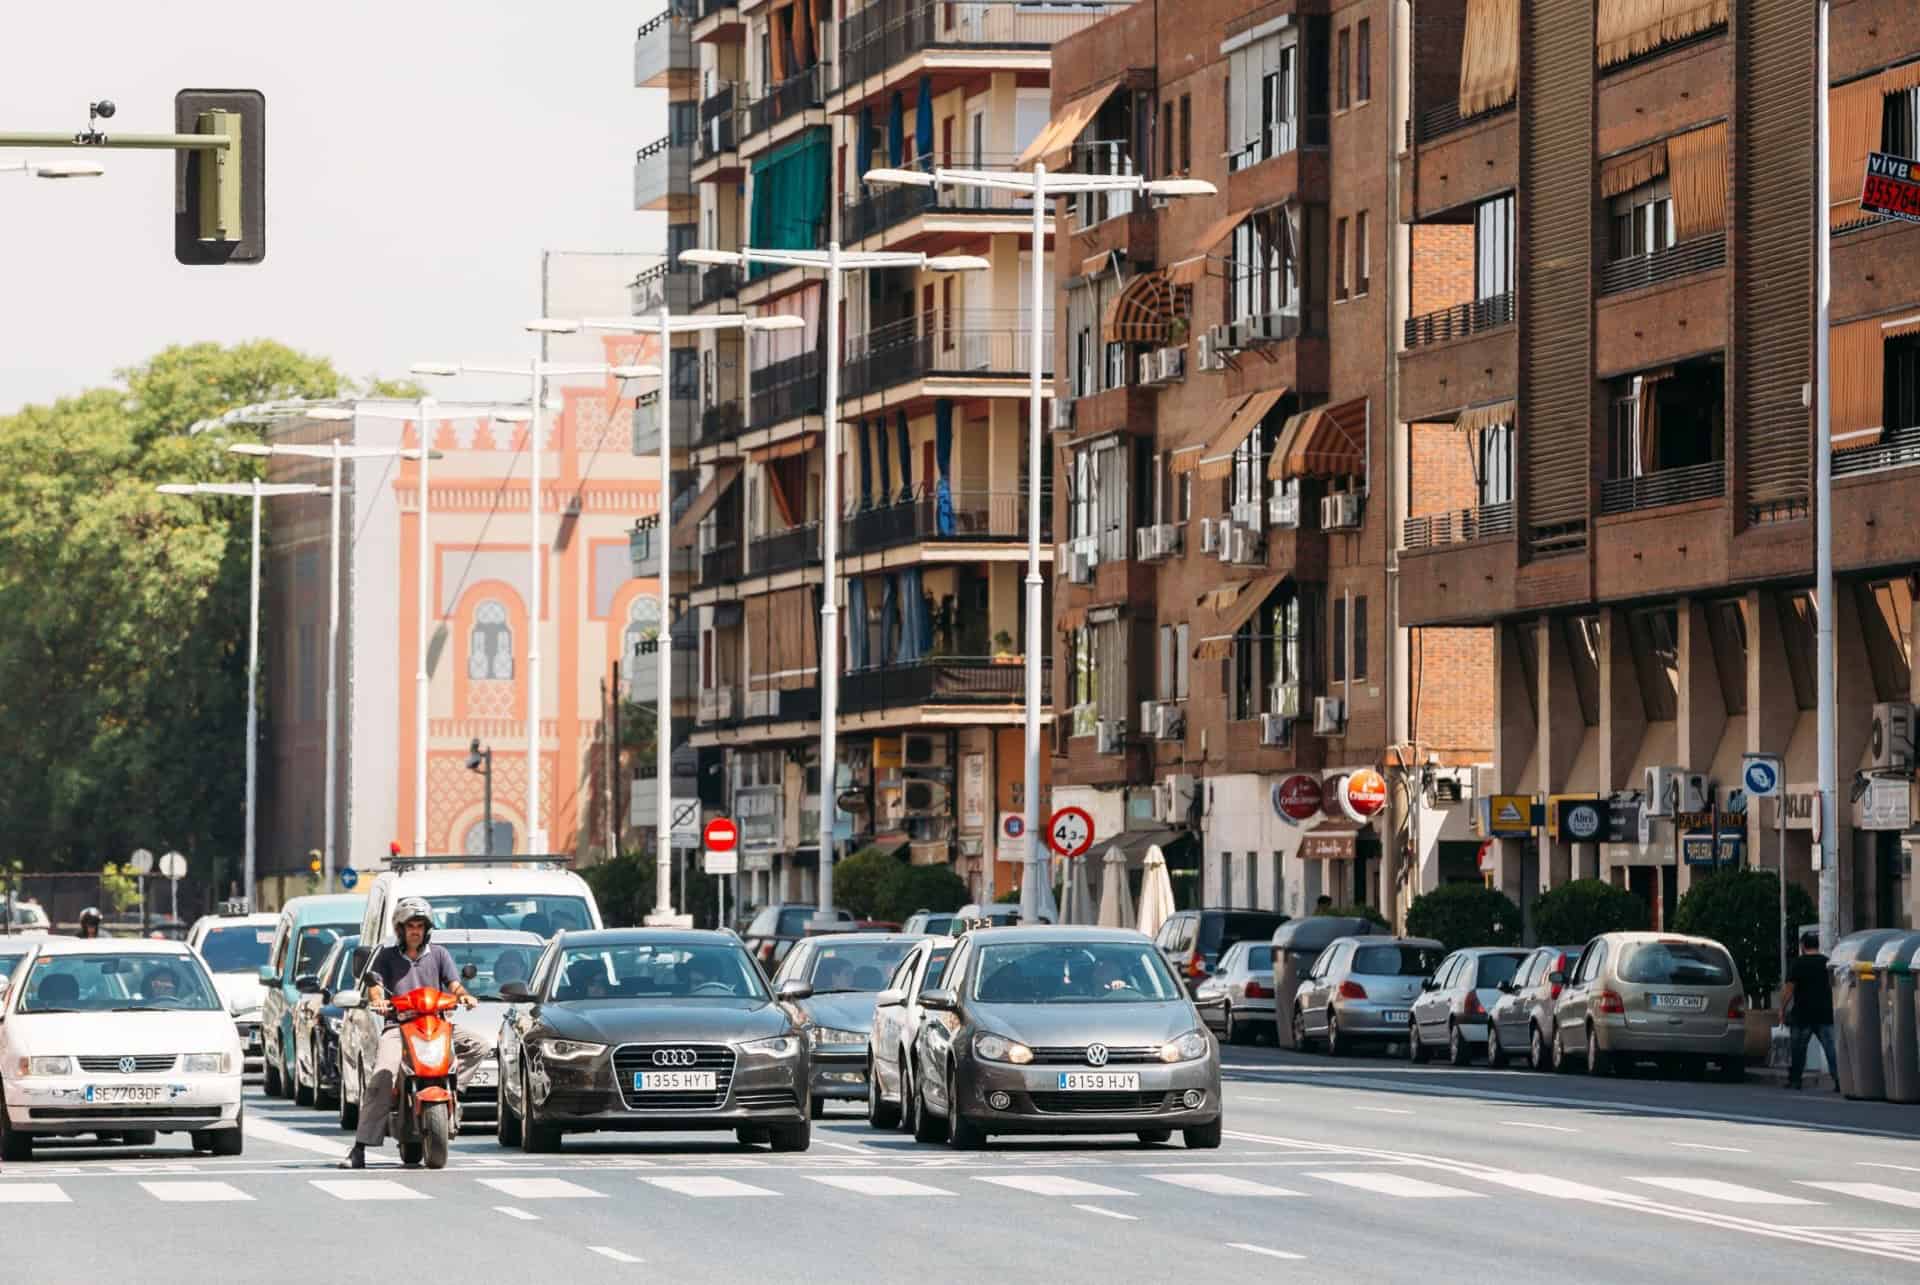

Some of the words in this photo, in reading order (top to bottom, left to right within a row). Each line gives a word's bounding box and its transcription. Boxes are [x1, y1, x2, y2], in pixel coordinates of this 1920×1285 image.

[645, 1074, 679, 1087] 1355
[684, 1074, 709, 1087] HYT
[1068, 1075, 1104, 1088] 8159
[1108, 1075, 1135, 1088] HJY
